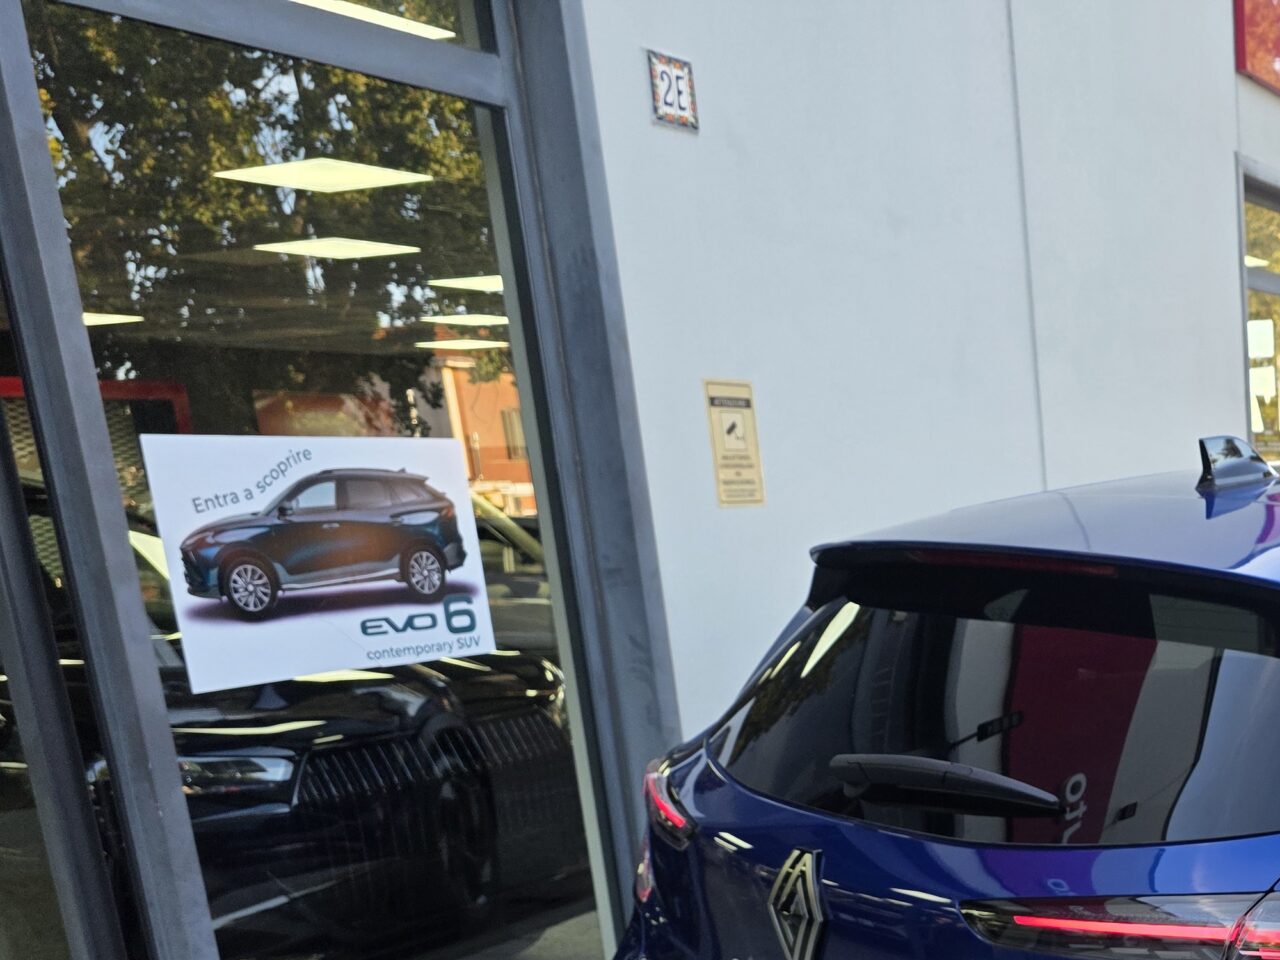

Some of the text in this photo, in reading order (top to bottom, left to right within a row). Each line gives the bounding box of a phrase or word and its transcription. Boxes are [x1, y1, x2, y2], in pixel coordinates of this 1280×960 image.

[660, 70, 687, 111] 2E
[192, 448, 313, 514] Entra a scoprire
[360, 593, 477, 636] EVO 6
[366, 635, 481, 661] contemporary SUV
